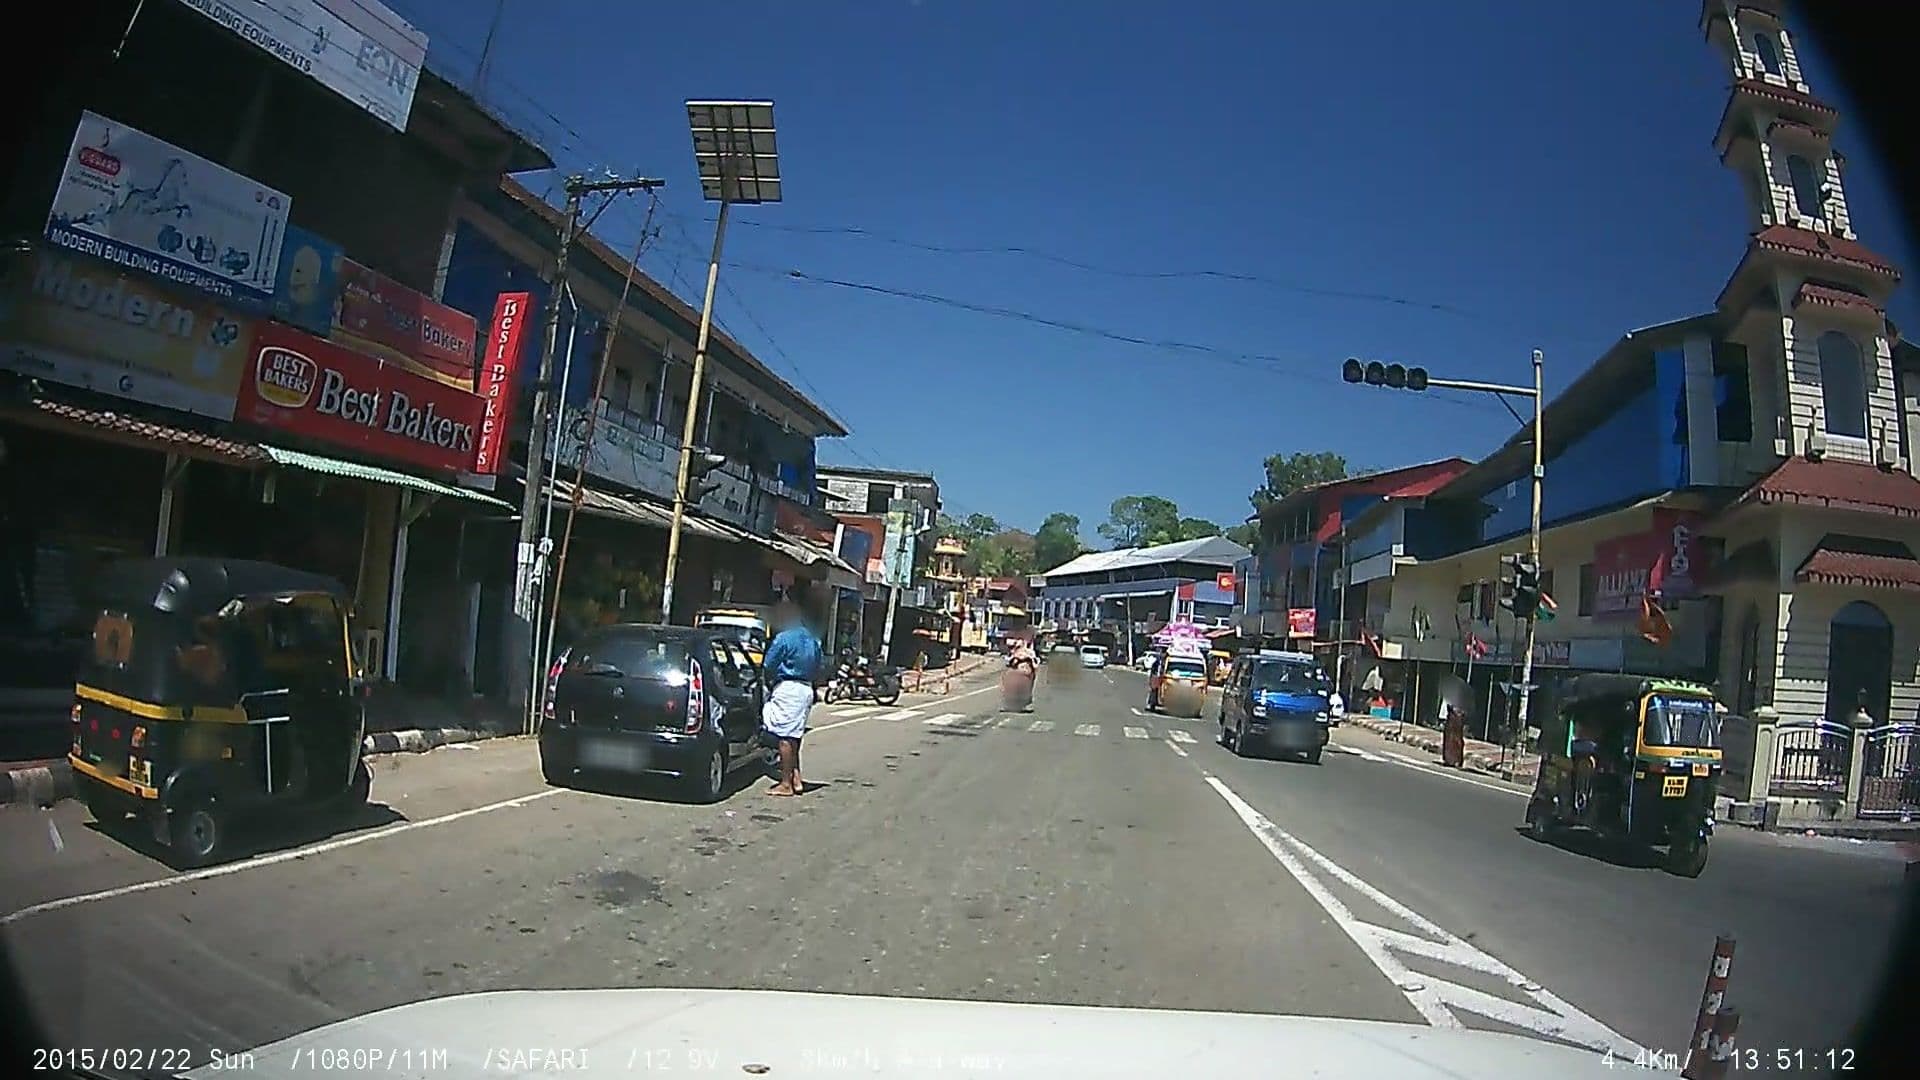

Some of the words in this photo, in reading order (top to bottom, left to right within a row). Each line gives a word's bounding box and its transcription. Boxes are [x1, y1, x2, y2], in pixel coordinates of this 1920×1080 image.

[242, 22, 313, 73] EQUIPMENTS
[32, 257, 195, 337] Modern
[51, 227, 102, 257] MODERN
[104, 244, 159, 274] BUILDING
[161, 262, 233, 297] EQUIPMENTS
[263, 368, 309, 393] BAKERS
[273, 353, 308, 377] BEST
[316, 367, 383, 427] Best
[385, 391, 474, 452] Bakers
[476, 363, 506, 466] Bakers
